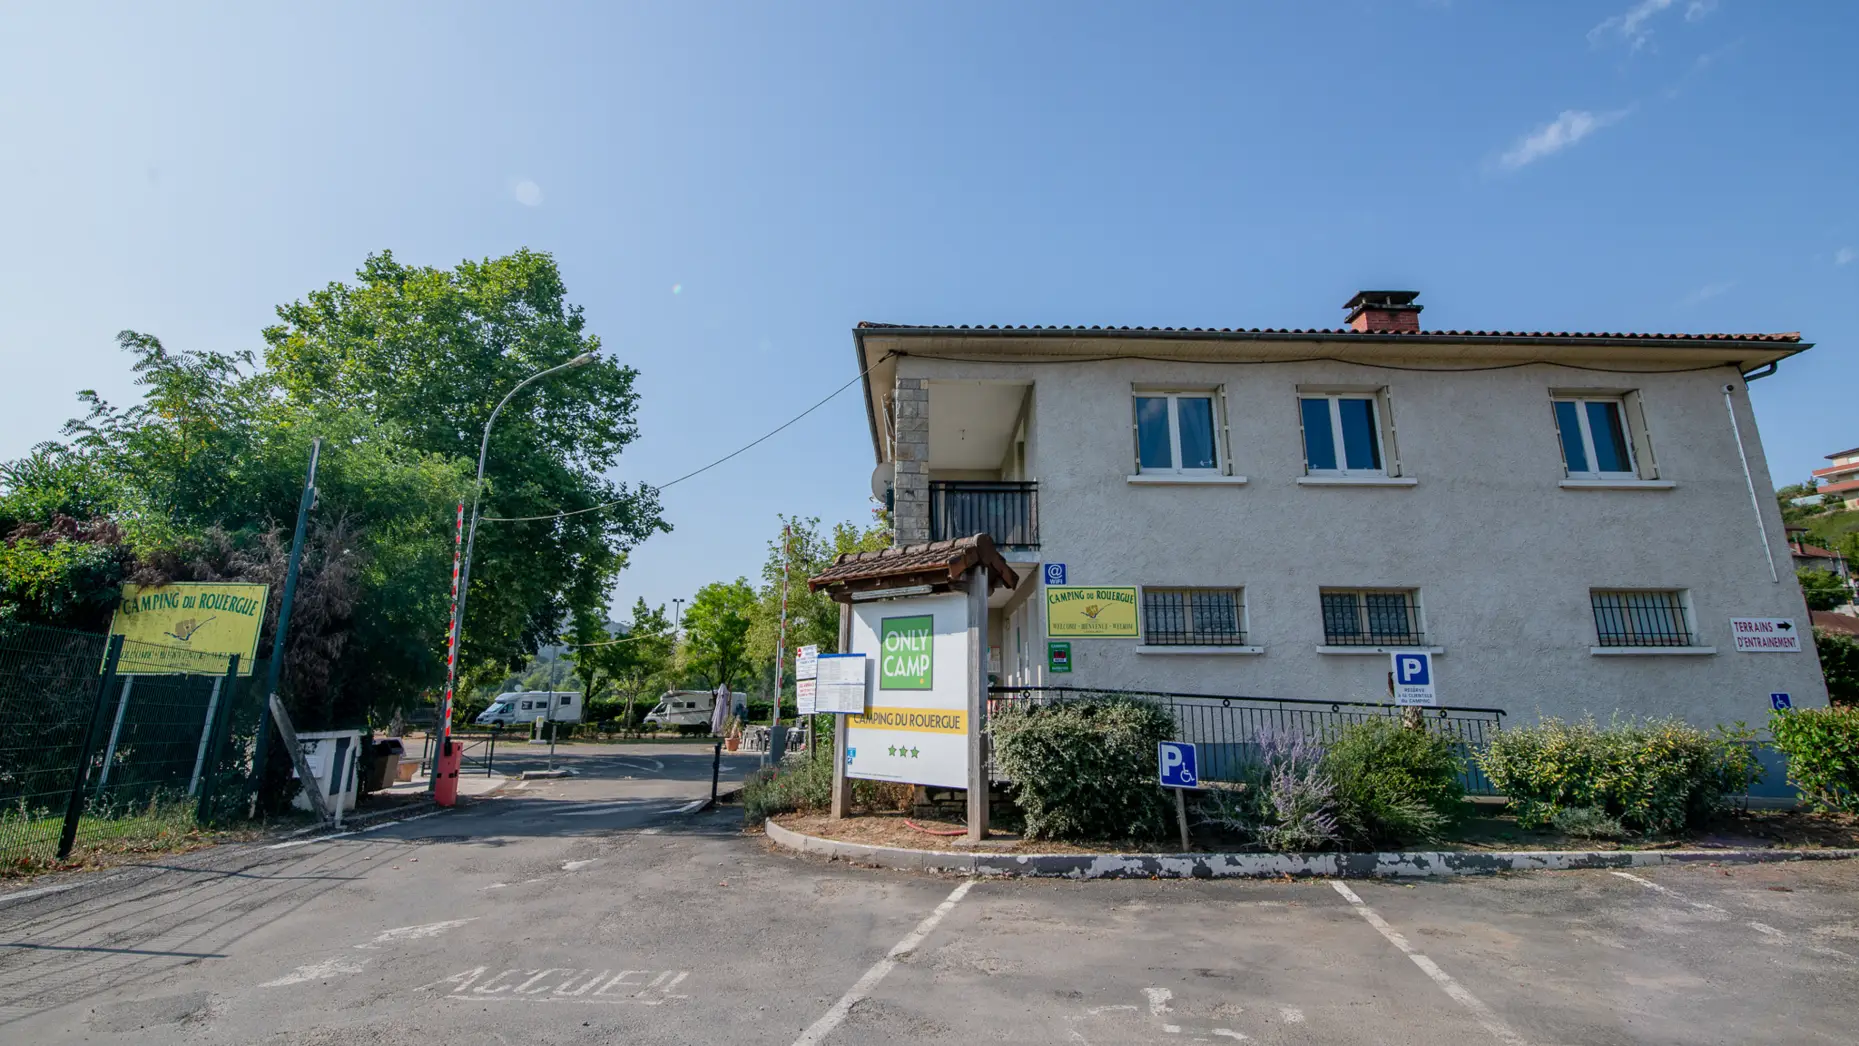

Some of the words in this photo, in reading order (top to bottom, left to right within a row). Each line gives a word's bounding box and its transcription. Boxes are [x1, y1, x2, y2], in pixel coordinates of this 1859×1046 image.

[123, 592, 180, 615] CAMPING
[200, 592, 259, 617] ROUERGUE
[1049, 590, 1085, 605] CAMPING
[1096, 590, 1134, 604] ROUERGUE
[1734, 622, 1773, 632] TERRAINS
[885, 629, 929, 652] ONLY
[1737, 636, 1797, 648] D'ENTRAINEMENT
[883, 654, 930, 677] CAMP
[1402, 658, 1422, 681] P
[853, 711, 894, 726] CAMPING
[894, 713, 908, 727] DU
[909, 714, 961, 730] ROUERGUE
[1161, 744, 1183, 777] P
[412, 966, 690, 1000] ACCUEIL
